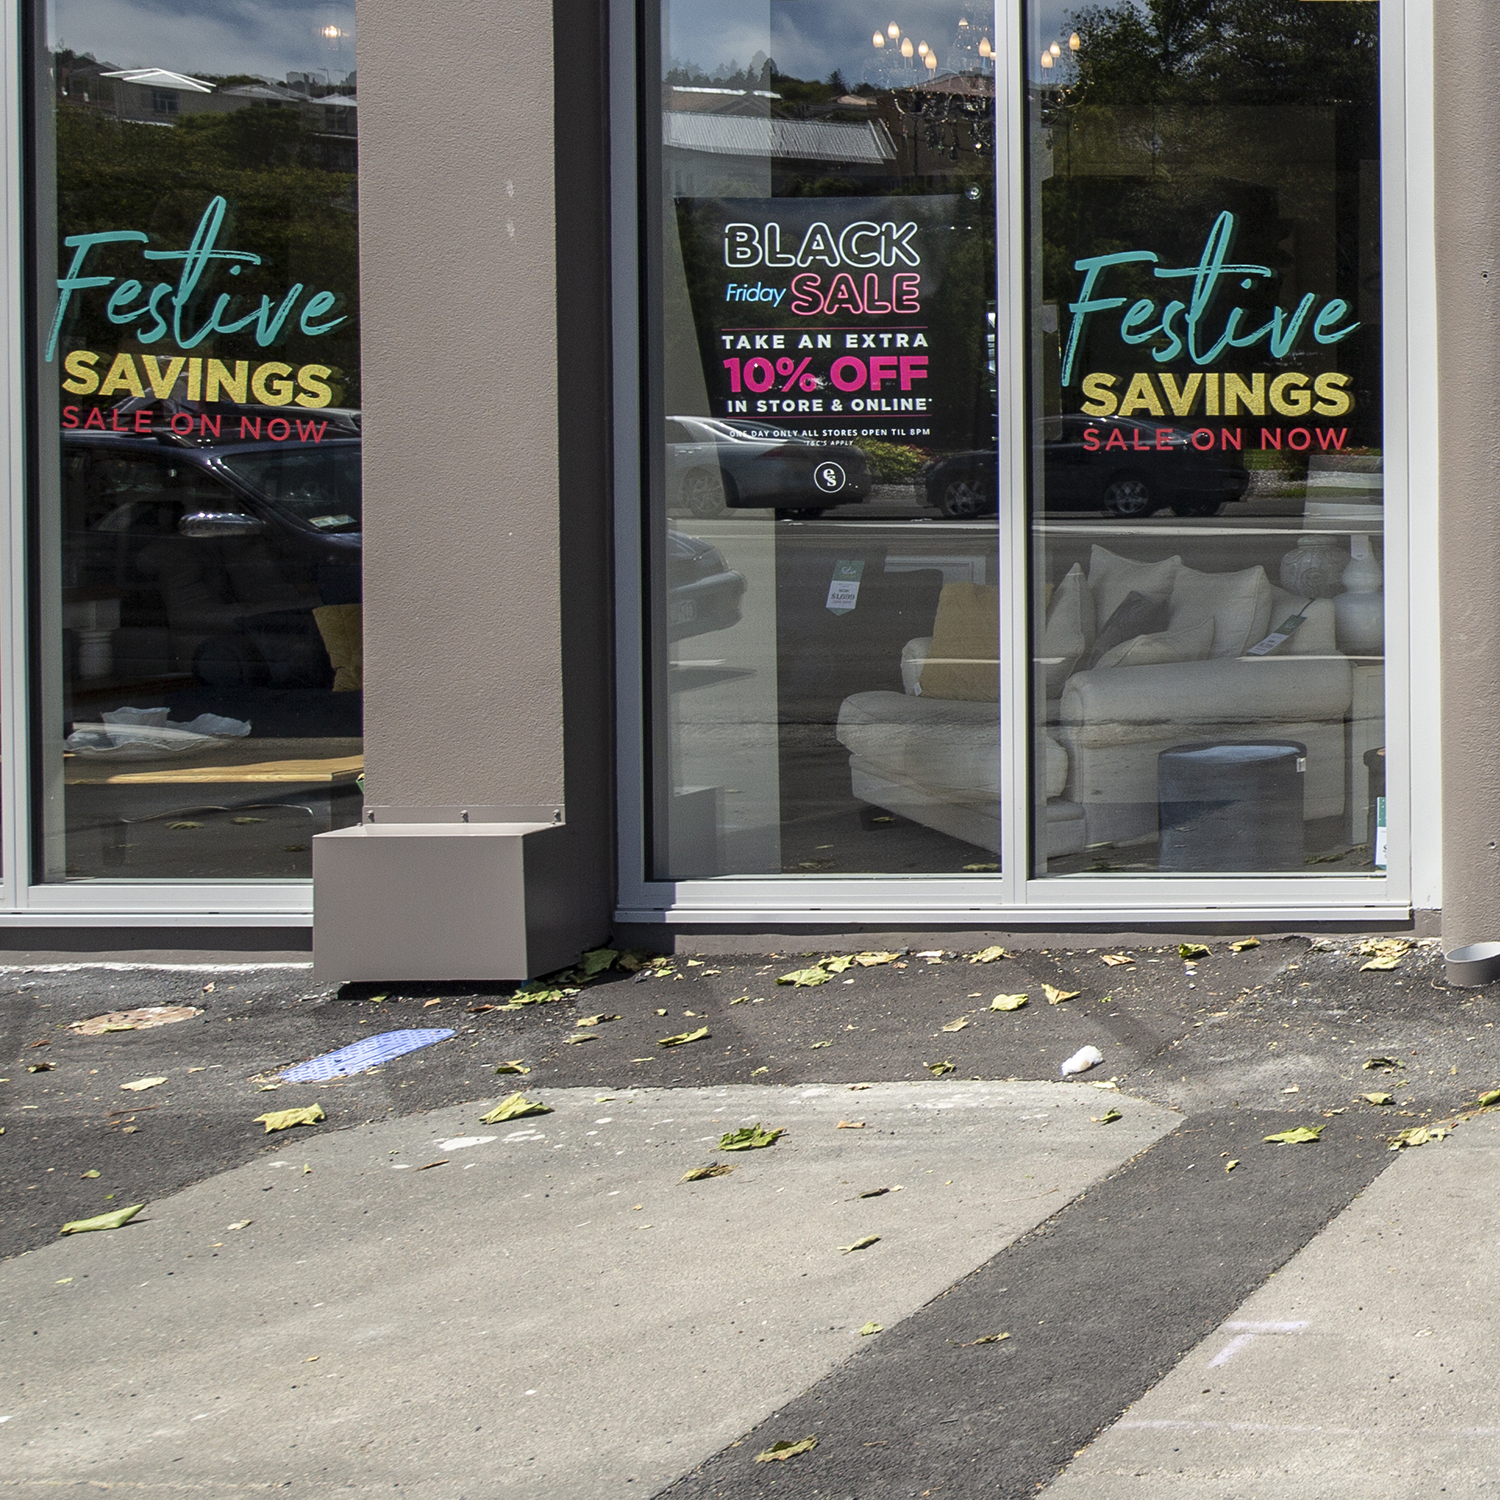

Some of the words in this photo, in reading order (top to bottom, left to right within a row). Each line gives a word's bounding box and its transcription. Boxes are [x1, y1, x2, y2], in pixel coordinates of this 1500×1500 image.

[725, 222, 920, 268] BLACK
[45, 195, 347, 361] Festive
[725, 282, 787, 307] Friday
[791, 273, 920, 315] SALE
[1061, 210, 1361, 387] Festive
[722, 334, 785, 349] TAKE
[798, 334, 831, 349] AN
[846, 333, 929, 348] EXTRA
[62, 350, 334, 408] SAVINGS
[723, 356, 816, 393] 10%
[830, 355, 929, 391] OFF
[728, 399, 747, 412] IN
[757, 399, 823, 412] STORE
[831, 399, 843, 411] &
[1080, 371, 1352, 418] SAVINGS
[62, 405, 154, 434] SALE
[171, 411, 222, 438] ON
[240, 417, 329, 444] NOW
[730, 430, 748, 438] ONE
[751, 429, 770, 438] DAY
[772, 429, 799, 438] ONLY
[802, 429, 819, 437] ALL
[822, 428, 858, 437] STORES
[861, 428, 888, 437] OPEN
[891, 428, 906, 436] TIL
[909, 428, 931, 436] 8PM
[1083, 427, 1175, 451] SALE
[1191, 427, 1242, 451] ON
[1260, 427, 1348, 451] NOW
